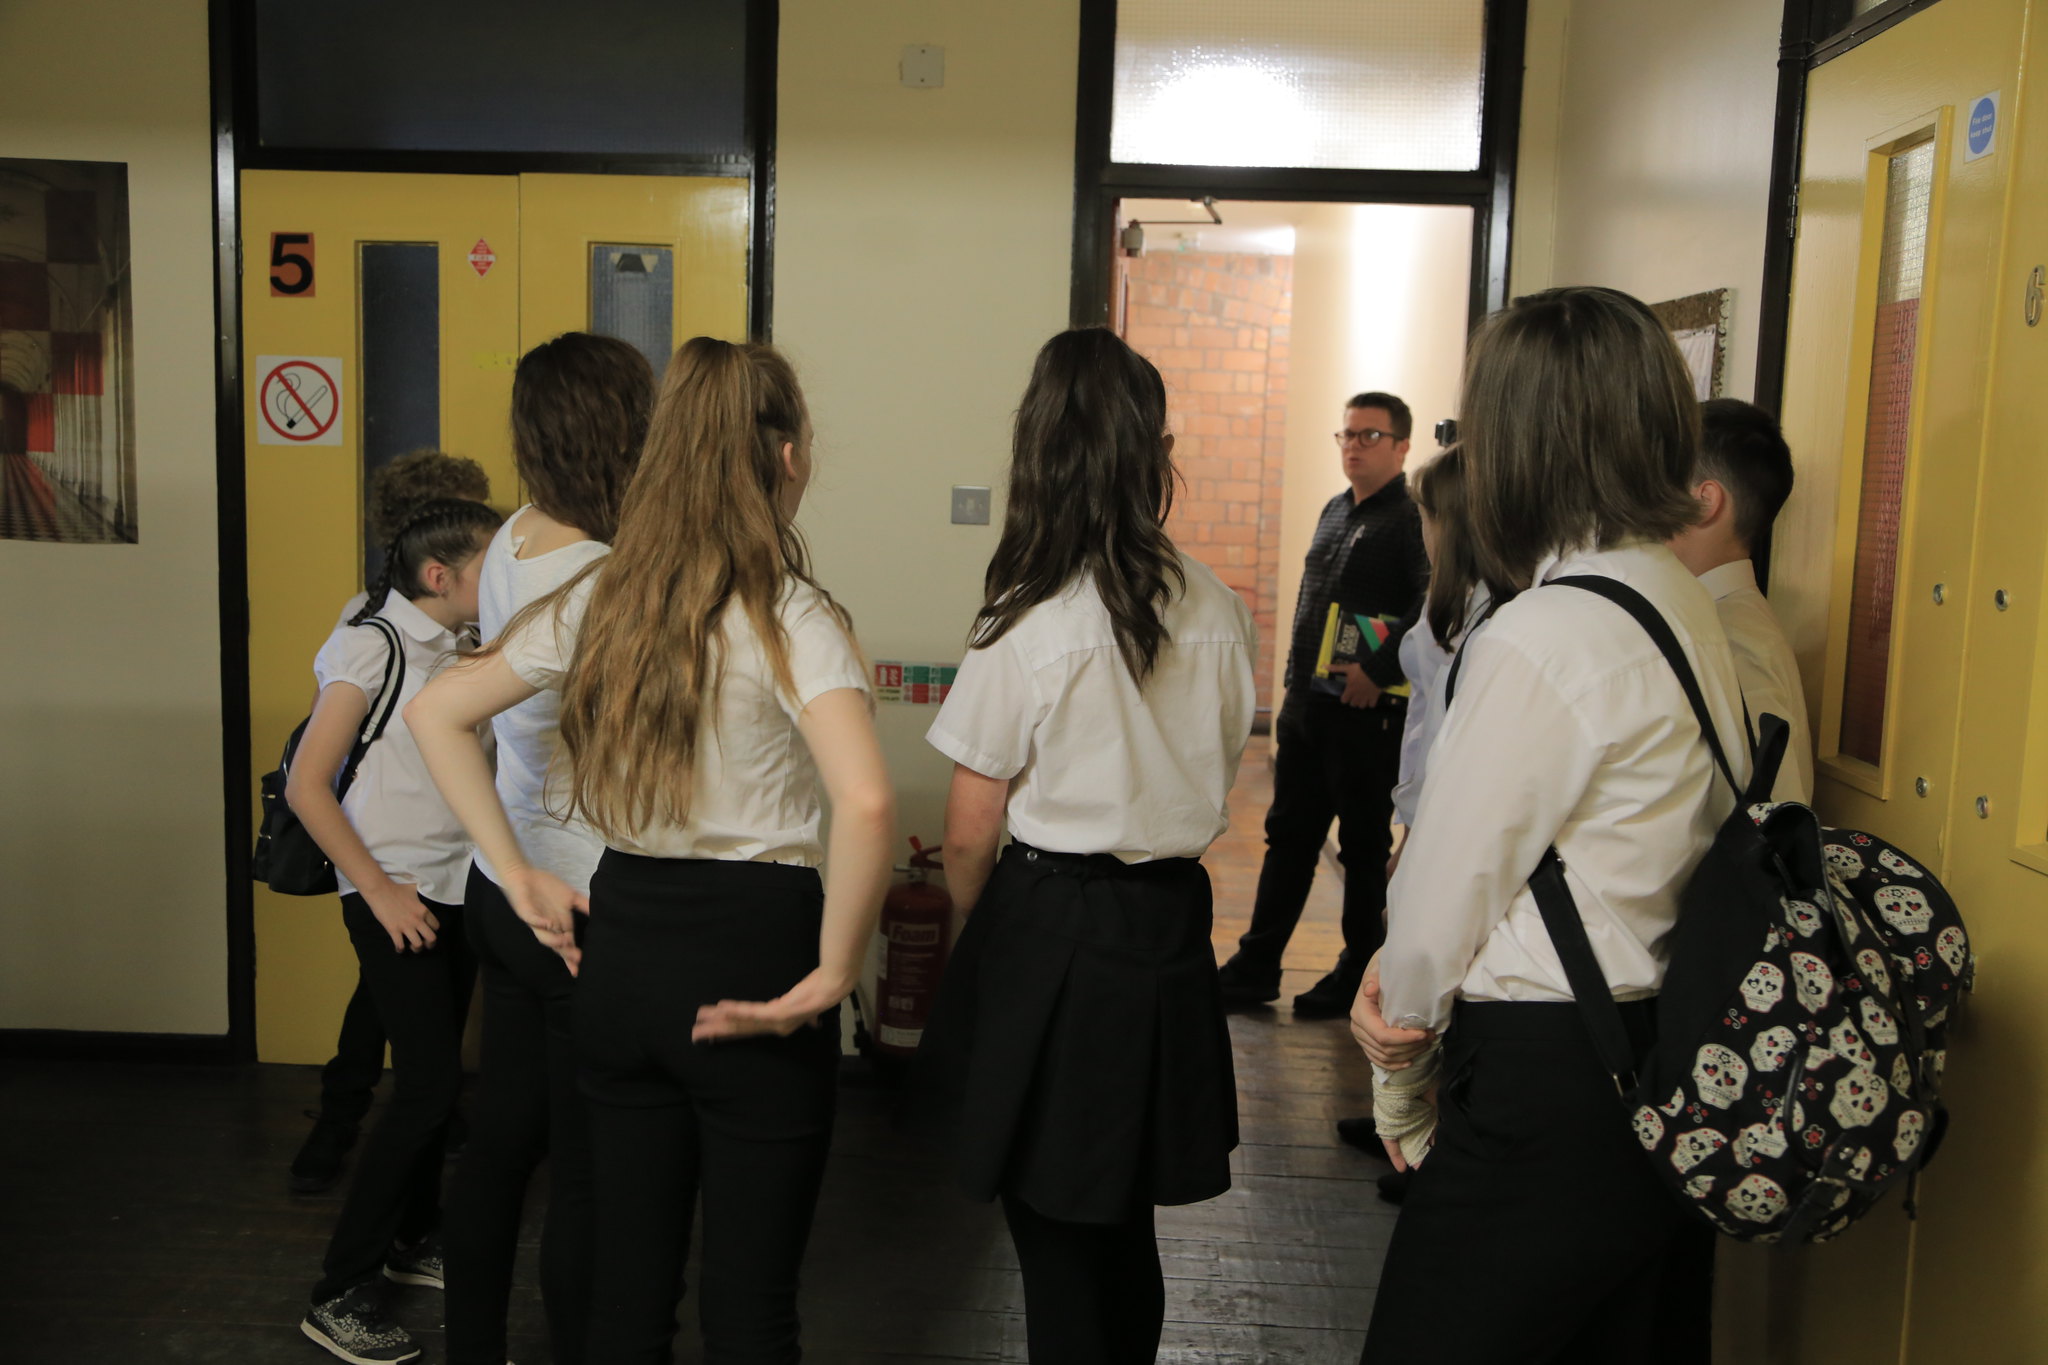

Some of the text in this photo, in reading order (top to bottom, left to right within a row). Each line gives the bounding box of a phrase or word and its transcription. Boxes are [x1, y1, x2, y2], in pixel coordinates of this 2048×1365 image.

[270, 235, 313, 294] 5
[2024, 264, 2045, 328] 6
[894, 925, 936, 941] Foam
